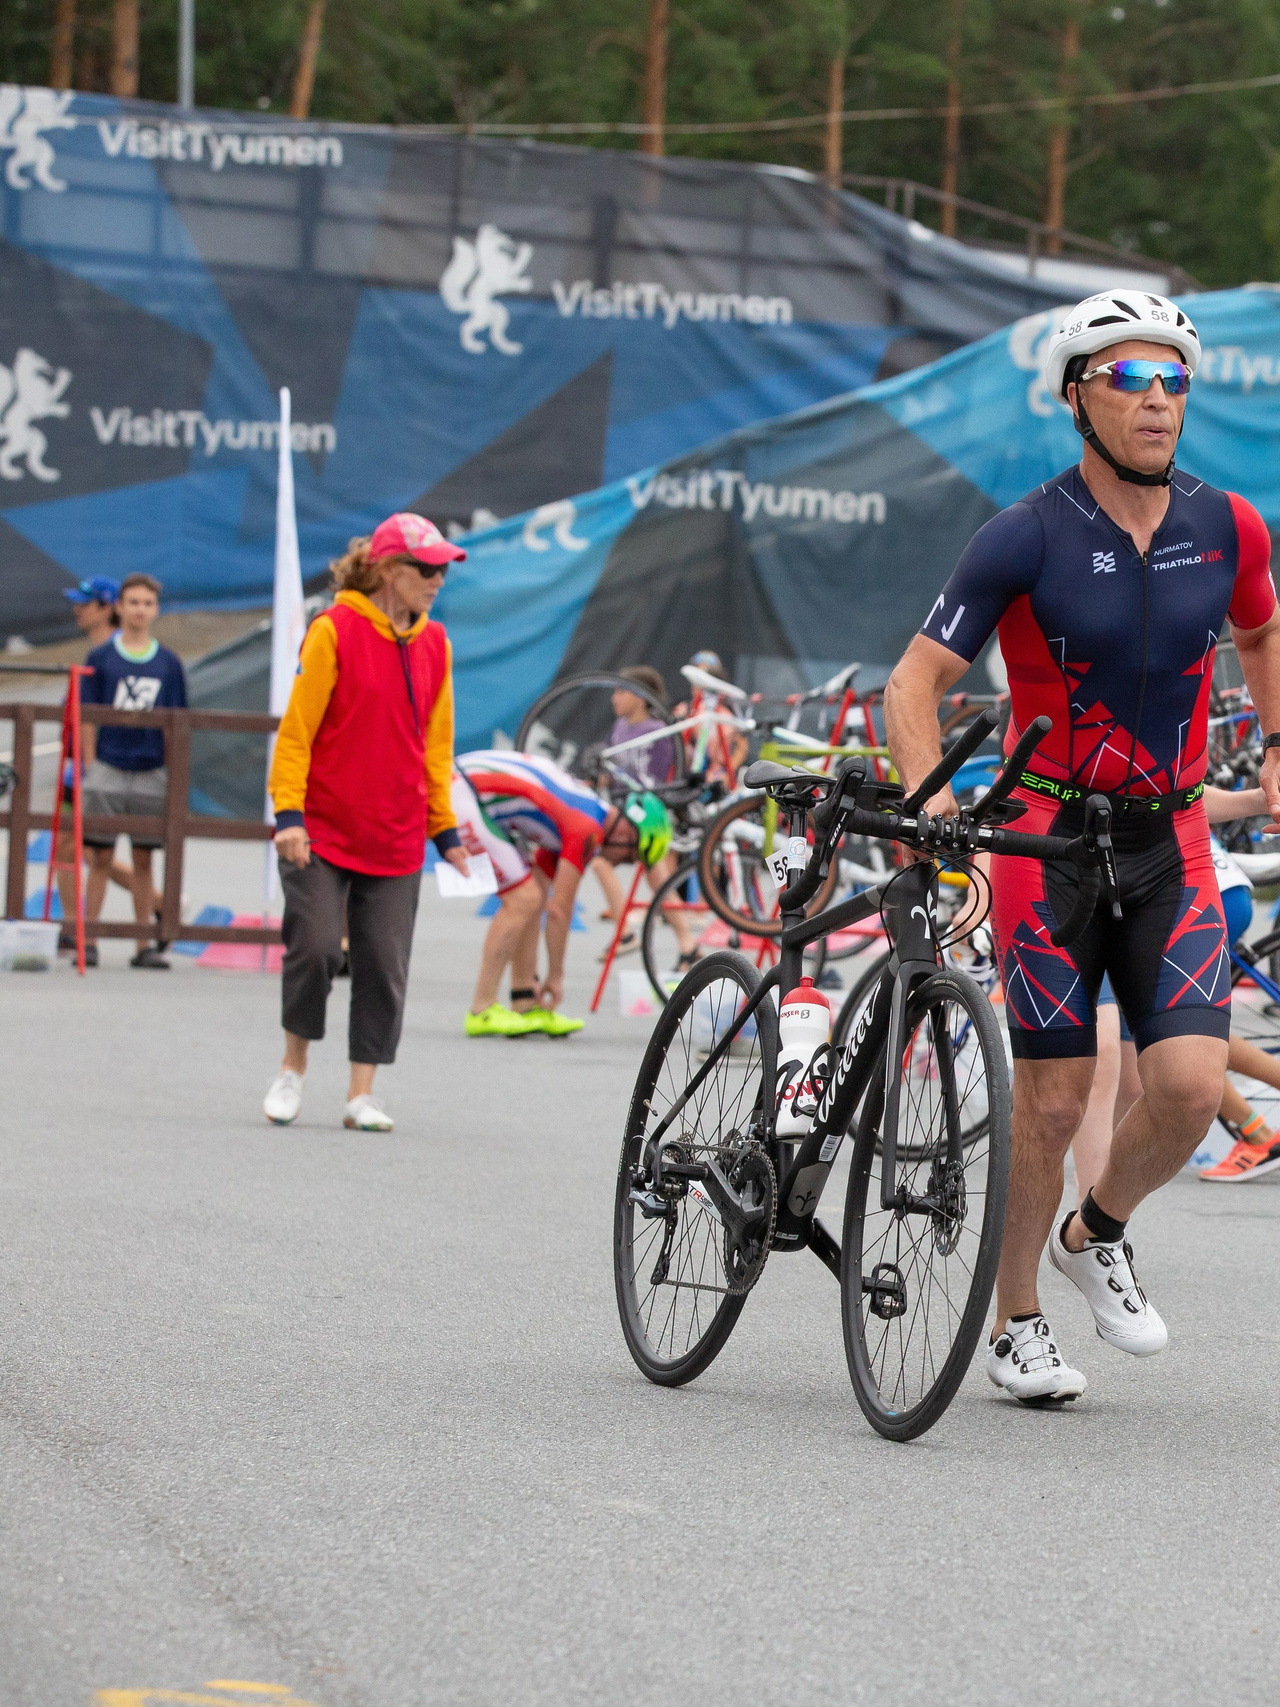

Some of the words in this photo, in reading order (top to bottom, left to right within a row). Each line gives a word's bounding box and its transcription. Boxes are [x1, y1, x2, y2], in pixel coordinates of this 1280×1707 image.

[97, 118, 344, 172] VisitTyumen
[551, 278, 795, 331] VisitTyumen
[1151, 310, 1170, 323] 58
[1068, 321, 1083, 336] 58
[88, 406, 338, 458] VisitTyumen
[1153, 541, 1194, 557] NURMATOV
[780, 1010, 800, 1019] ONSER
